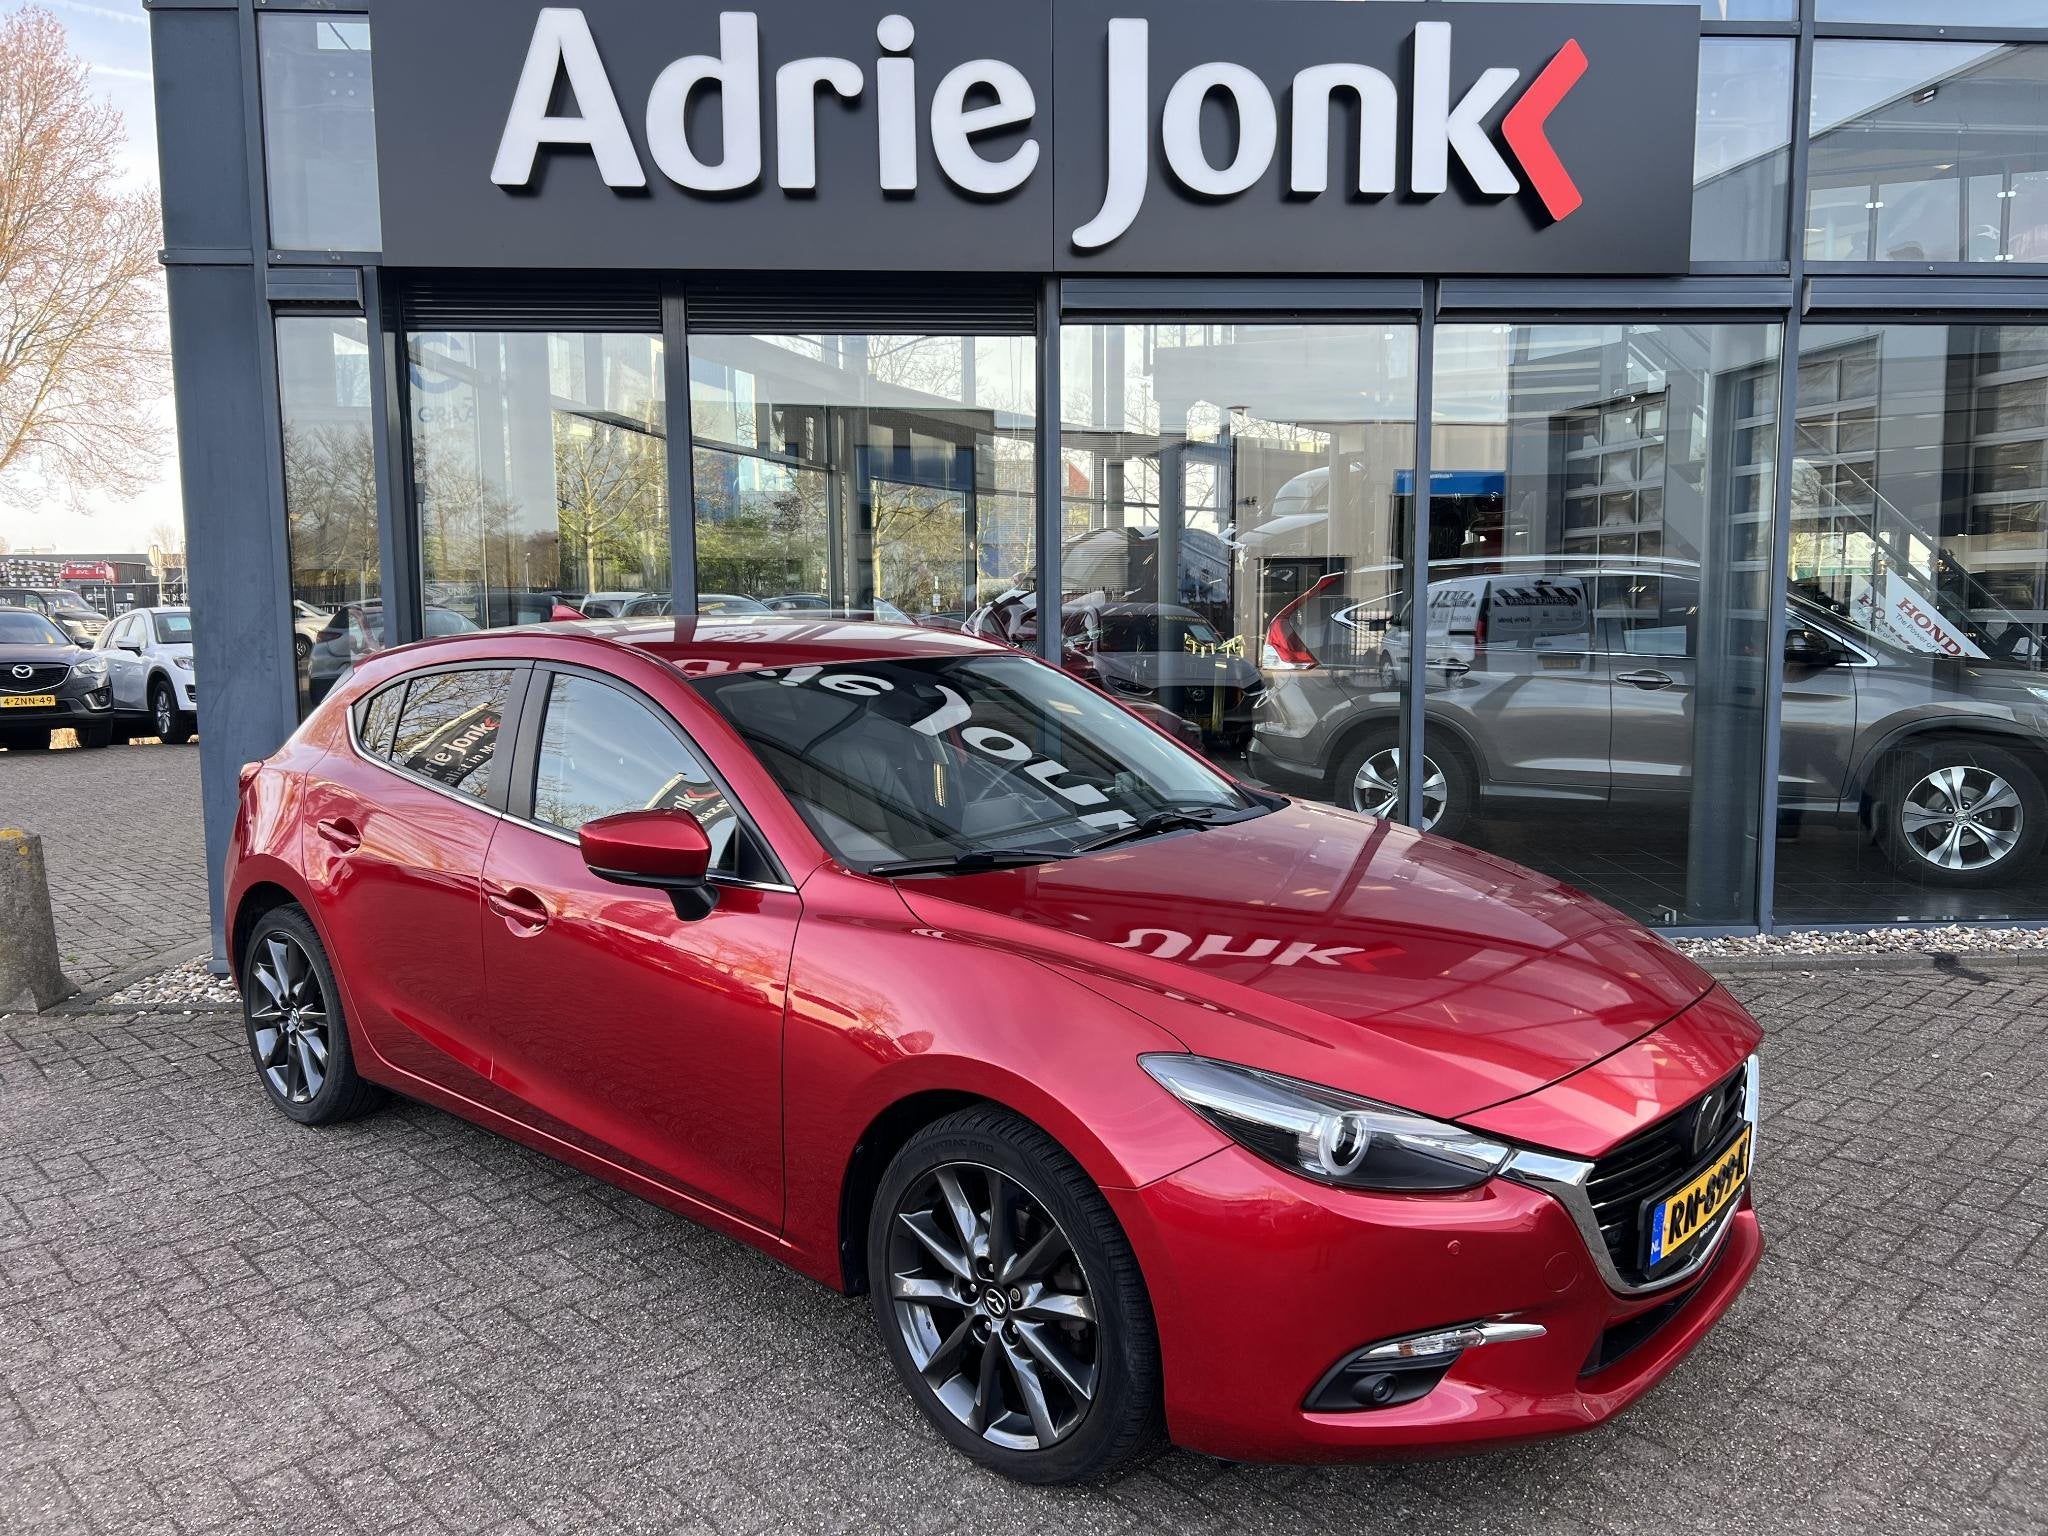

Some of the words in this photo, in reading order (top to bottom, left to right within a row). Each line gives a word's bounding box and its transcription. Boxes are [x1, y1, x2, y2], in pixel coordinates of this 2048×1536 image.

[491, 8, 1040, 194] Adrie
[1072, 18, 1520, 248] Jonk
[1896, 597, 1970, 657] HOND
[4, 696, 52, 706] 4-ZNN-49
[441, 722, 496, 756] Jonk
[695, 798, 730, 824] Mazd
